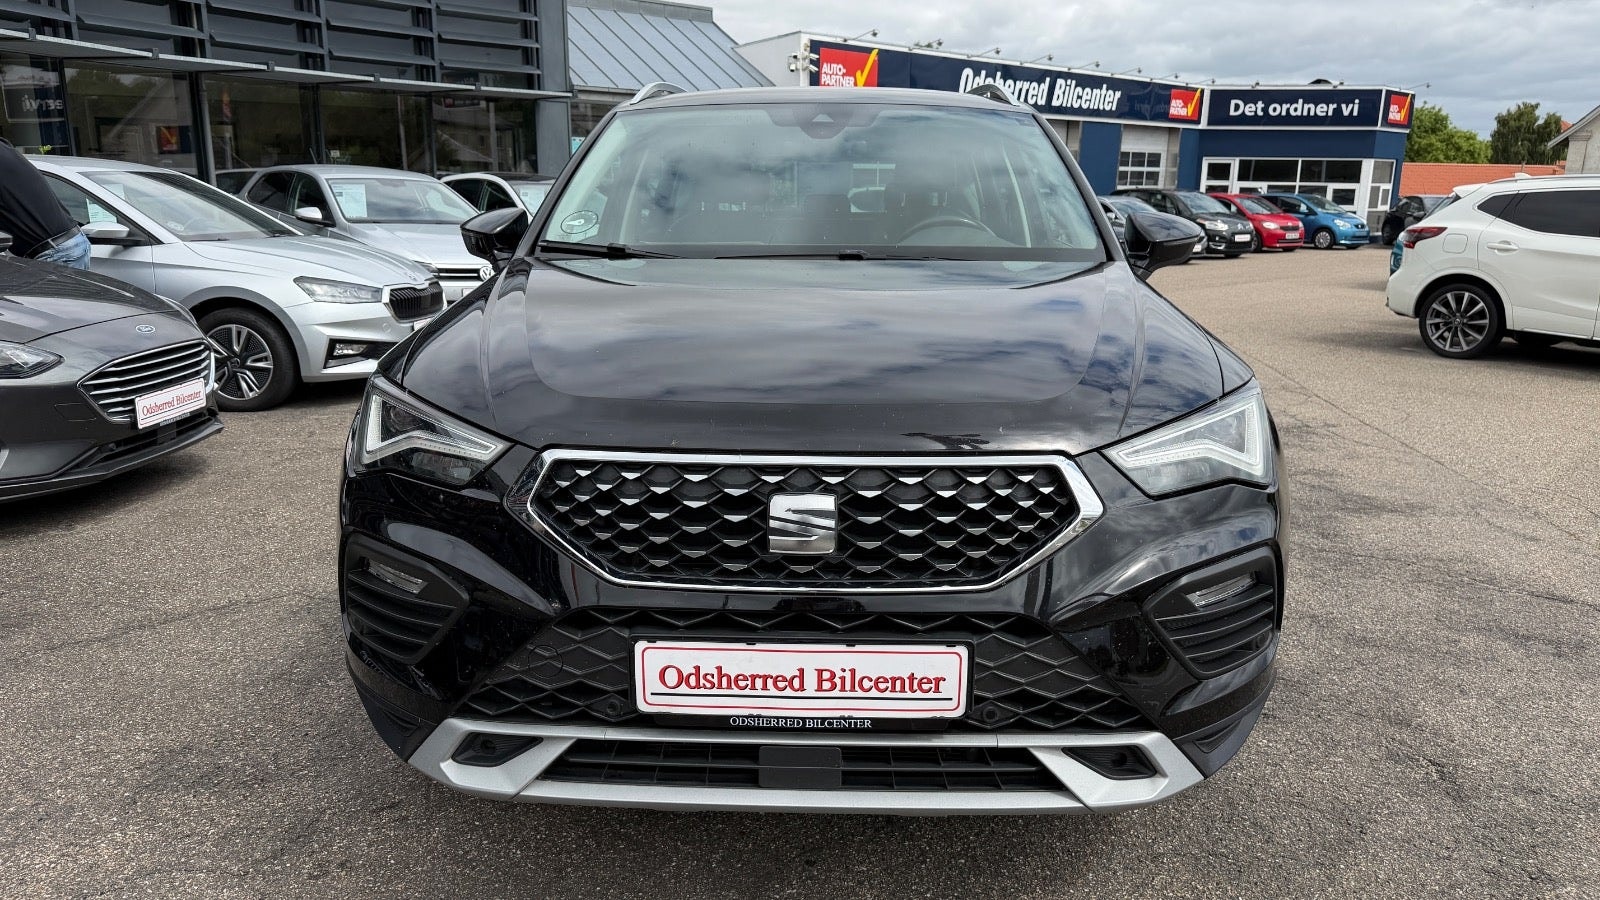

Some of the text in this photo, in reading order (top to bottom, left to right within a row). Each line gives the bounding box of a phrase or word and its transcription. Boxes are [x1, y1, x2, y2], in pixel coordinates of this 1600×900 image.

[822, 62, 847, 76] AUTO-
[821, 74, 855, 88] PARTNER
[1051, 78, 1121, 111] Bilcenter
[1229, 98, 1360, 116] Det ordner vi
[142, 390, 201, 416] Odsherred Bilcenter
[658, 664, 947, 694] Odsherred Bilcenter
[729, 716, 872, 728] ODSHERRED BILCENTER
